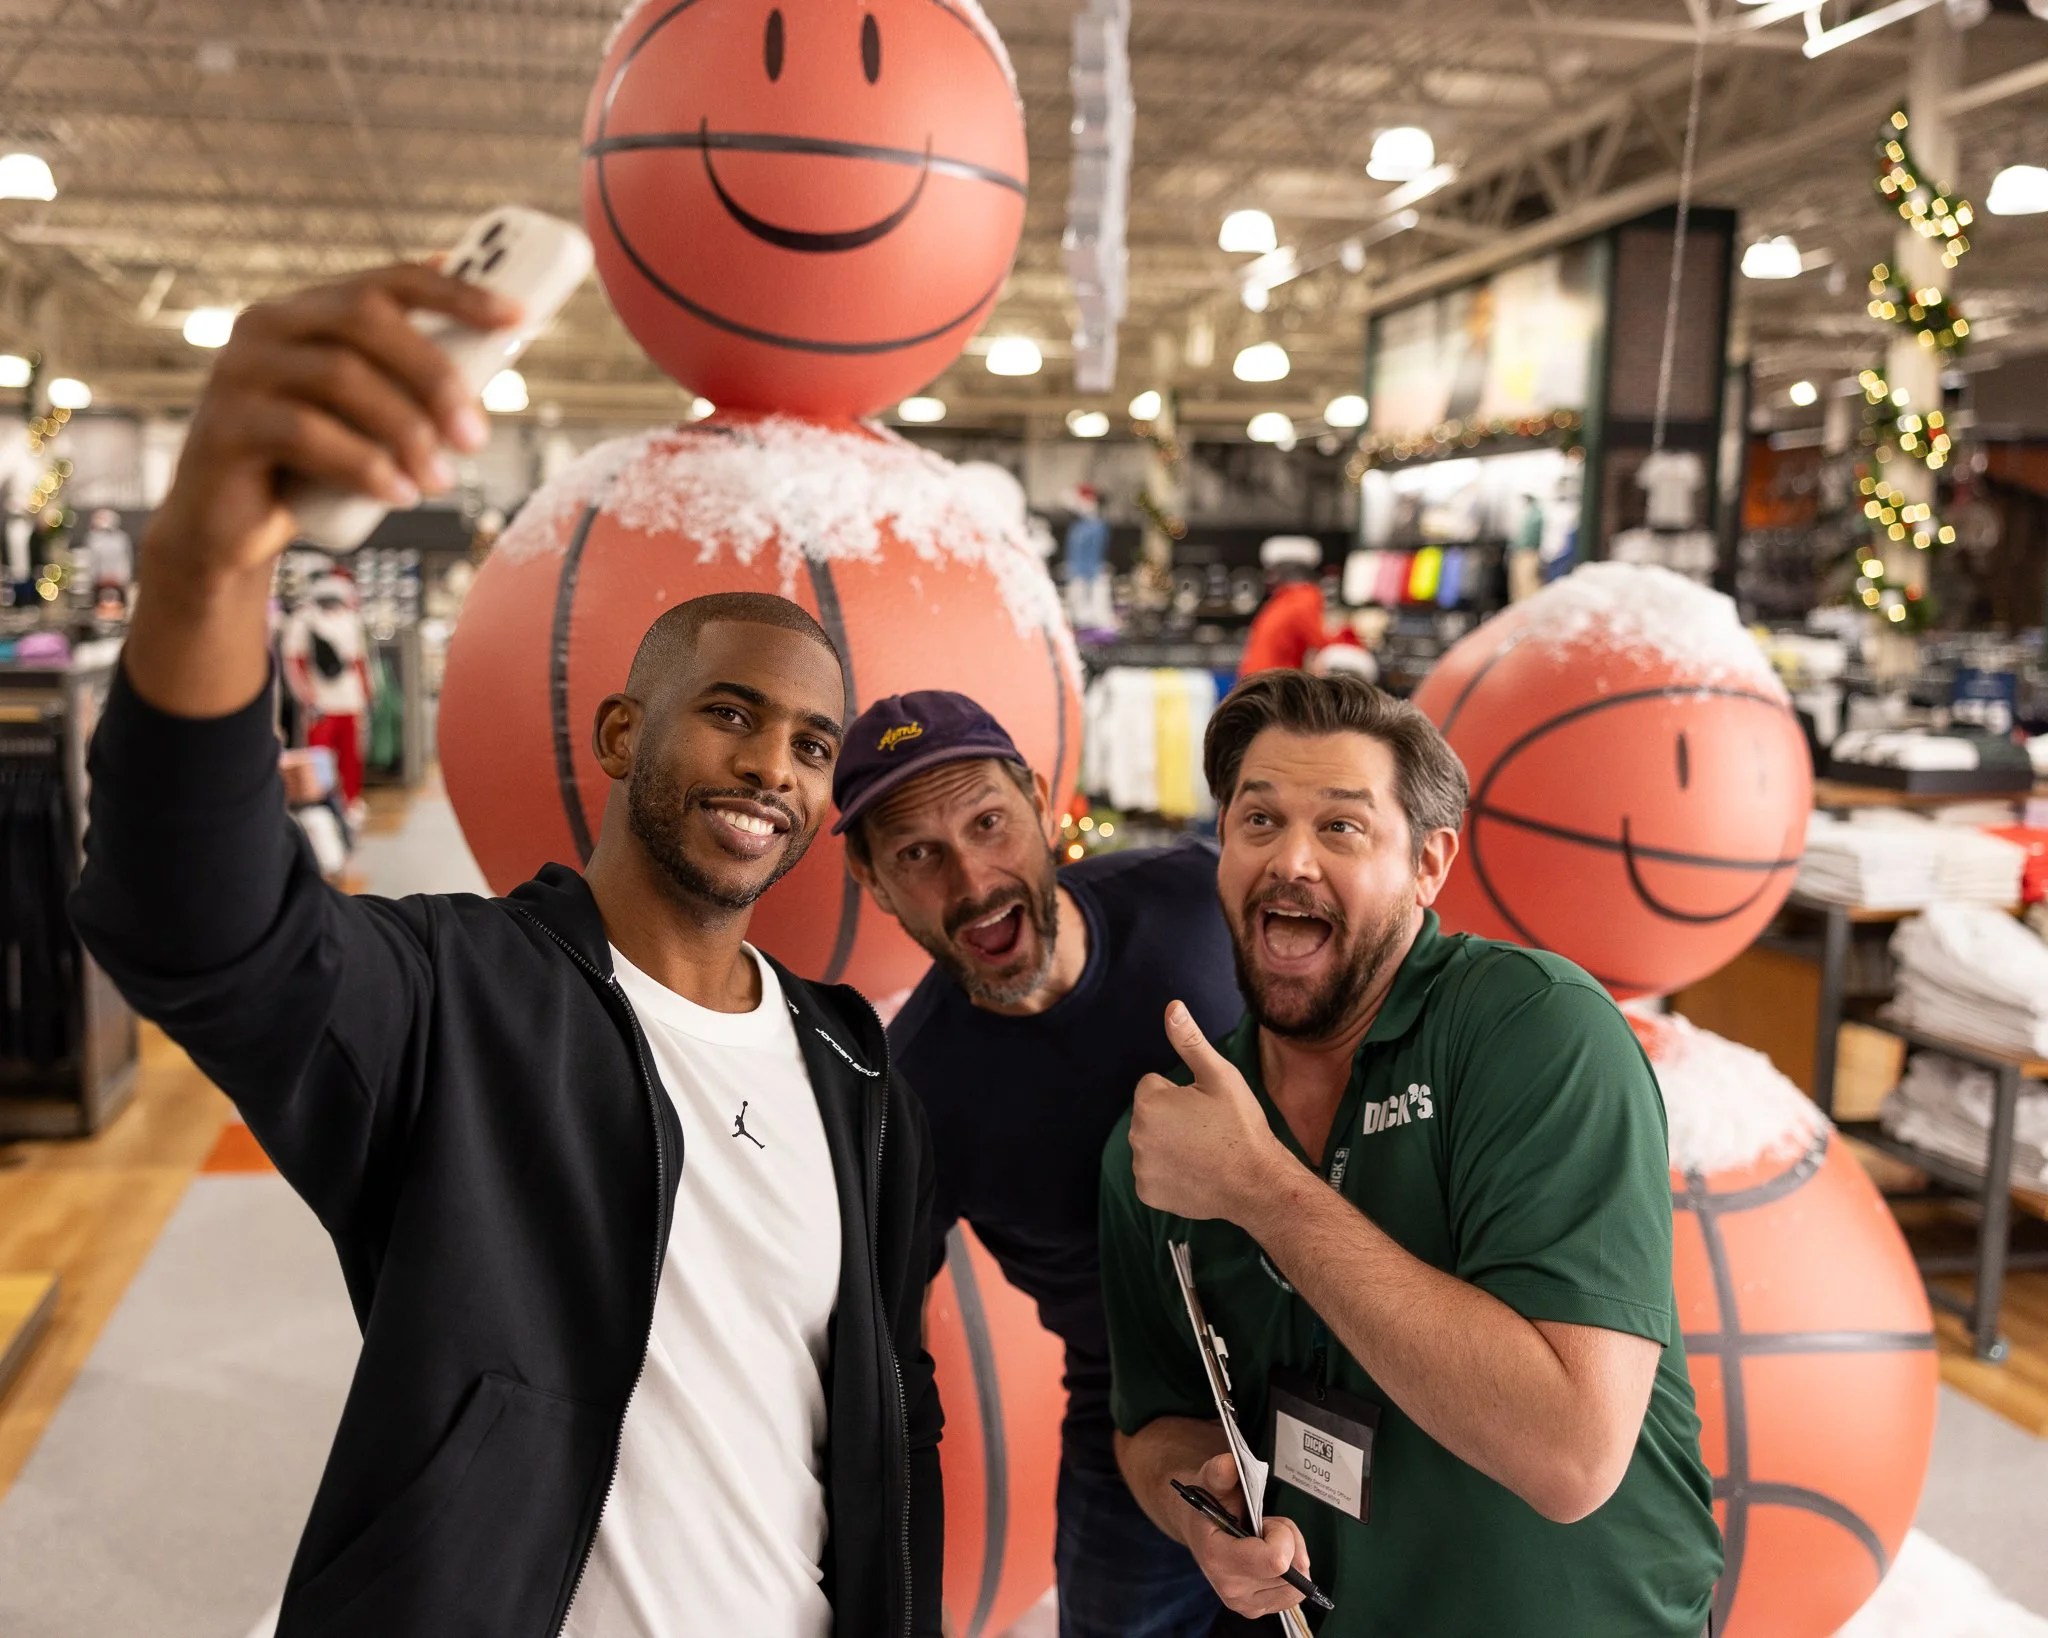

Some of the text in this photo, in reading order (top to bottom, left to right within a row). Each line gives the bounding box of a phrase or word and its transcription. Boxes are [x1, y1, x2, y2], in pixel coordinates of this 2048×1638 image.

[1363, 1083, 1434, 1135] DICK'S
[1304, 1435, 1333, 1459] DICK'S
[1304, 1458, 1331, 1482] Doug
